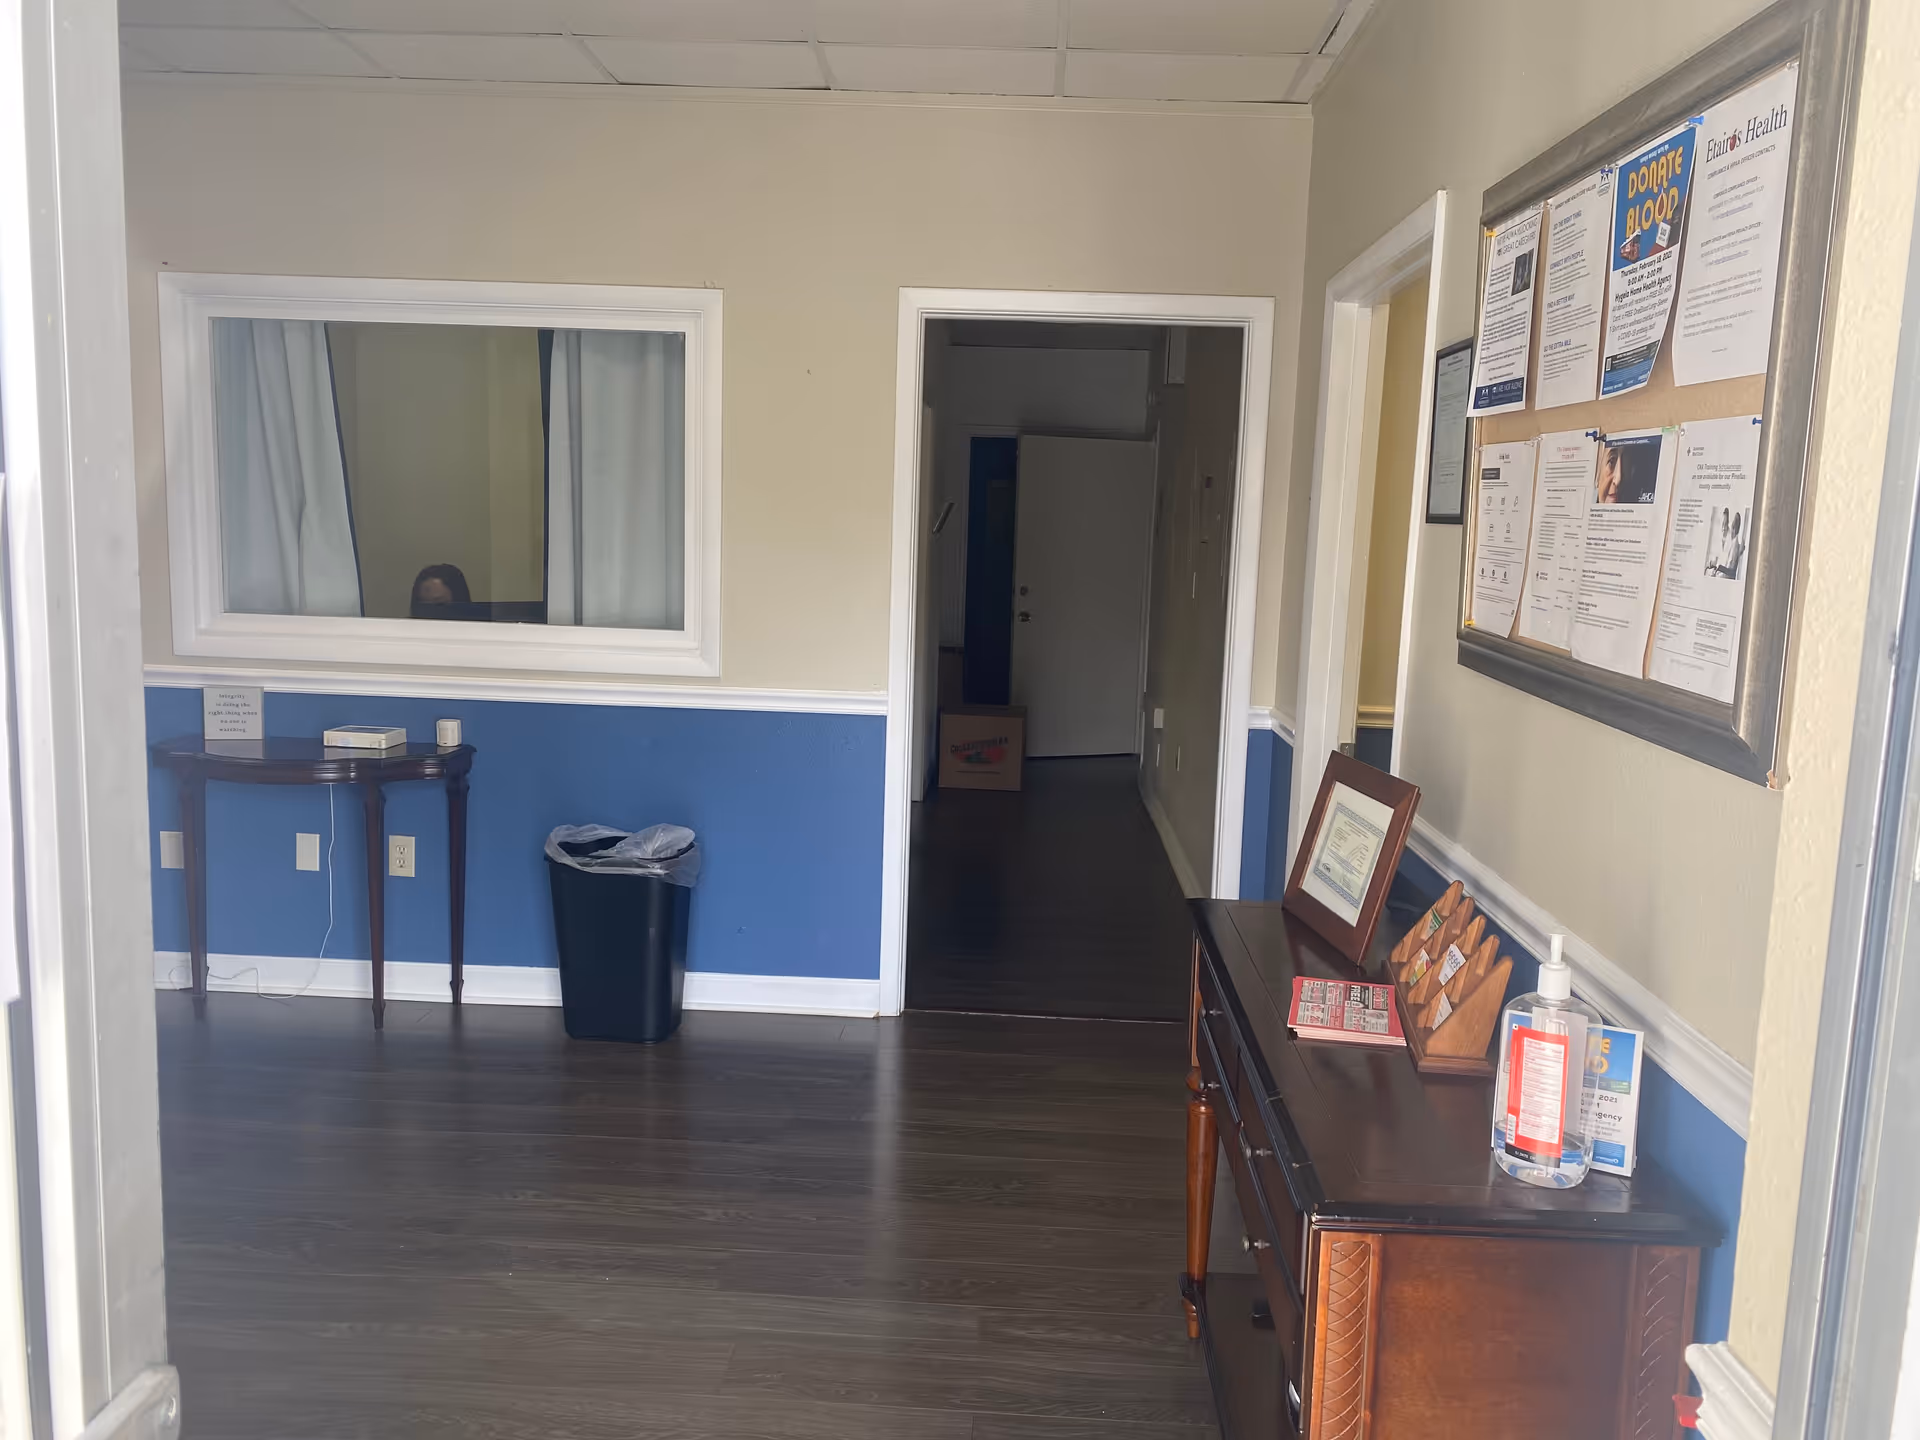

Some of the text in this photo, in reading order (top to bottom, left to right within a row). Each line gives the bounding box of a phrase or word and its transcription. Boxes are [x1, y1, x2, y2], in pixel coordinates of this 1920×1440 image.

[1745, 104, 1788, 143] Health
[1755, 144, 1776, 158] CONTACTS
[1628, 146, 1684, 200] DONATE
[1626, 186, 1679, 239] BLOOD
[1639, 260, 1656, 271] February
[1662, 250, 1673, 261] 2021
[1630, 286, 1642, 297] Home
[1642, 280, 1657, 292] Health
[1657, 274, 1672, 288] Agency
[1350, 985, 1360, 1002] FREE
[1599, 1093, 1618, 1104] 2021
